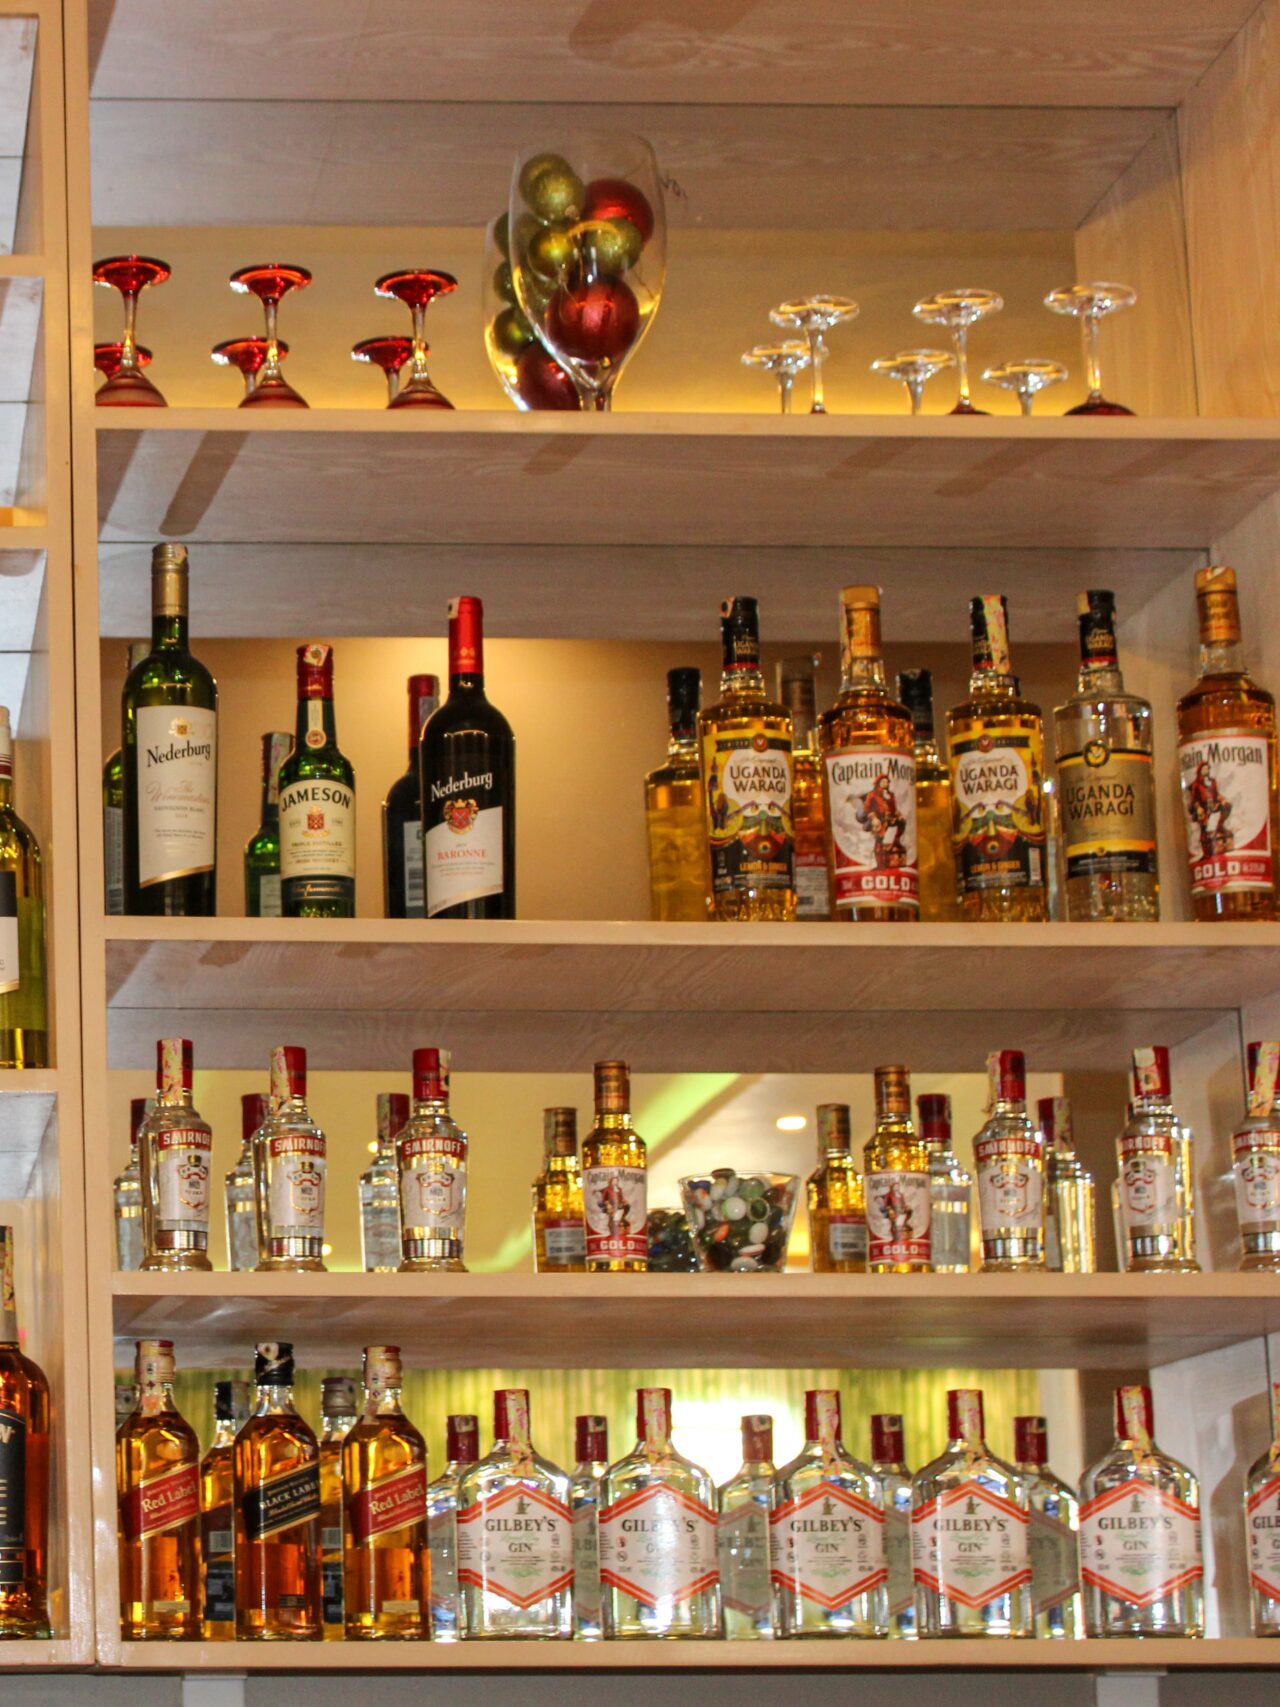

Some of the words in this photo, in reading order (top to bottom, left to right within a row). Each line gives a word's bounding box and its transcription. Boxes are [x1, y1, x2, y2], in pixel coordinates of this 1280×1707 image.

[146, 740, 211, 768] Nederburg
[1207, 742, 1263, 766] Morgan
[730, 765, 786, 780] UGANDA
[832, 758, 882, 785] Captain
[959, 765, 1018, 783] UGANDA
[431, 771, 493, 801] Nederburg
[733, 780, 786, 793] WARAGI
[962, 778, 1018, 796] WARAGI
[1066, 783, 1135, 804] UGANDA
[282, 787, 351, 812] JAMESON
[1069, 800, 1135, 820] WARAGI
[437, 848, 488, 861] BARONNE
[1194, 861, 1240, 880] GOLD
[861, 875, 910, 890] GOLD
[404, 1138, 462, 1155] SMIRNOFF
[978, 1140, 1036, 1158] SMIRNOFF
[600, 1241, 635, 1250] GOLD
[883, 1245, 918, 1255] GOLD
[141, 1493, 167, 1513] Red
[167, 1481, 197, 1503] Label
[259, 1492, 292, 1510] BLACK
[369, 1495, 395, 1515] Red
[394, 1483, 425, 1505] Label
[484, 1515, 557, 1532] GILBEY'S
[790, 1517, 863, 1533] GILBEY'S
[933, 1516, 1007, 1532] GILBEY'S
[1098, 1514, 1173, 1530] GILBEY'S
[508, 1543, 532, 1553] GIN
[815, 1543, 840, 1553] GIN
[958, 1542, 983, 1552] GIN
[1123, 1541, 1149, 1551] GIN
